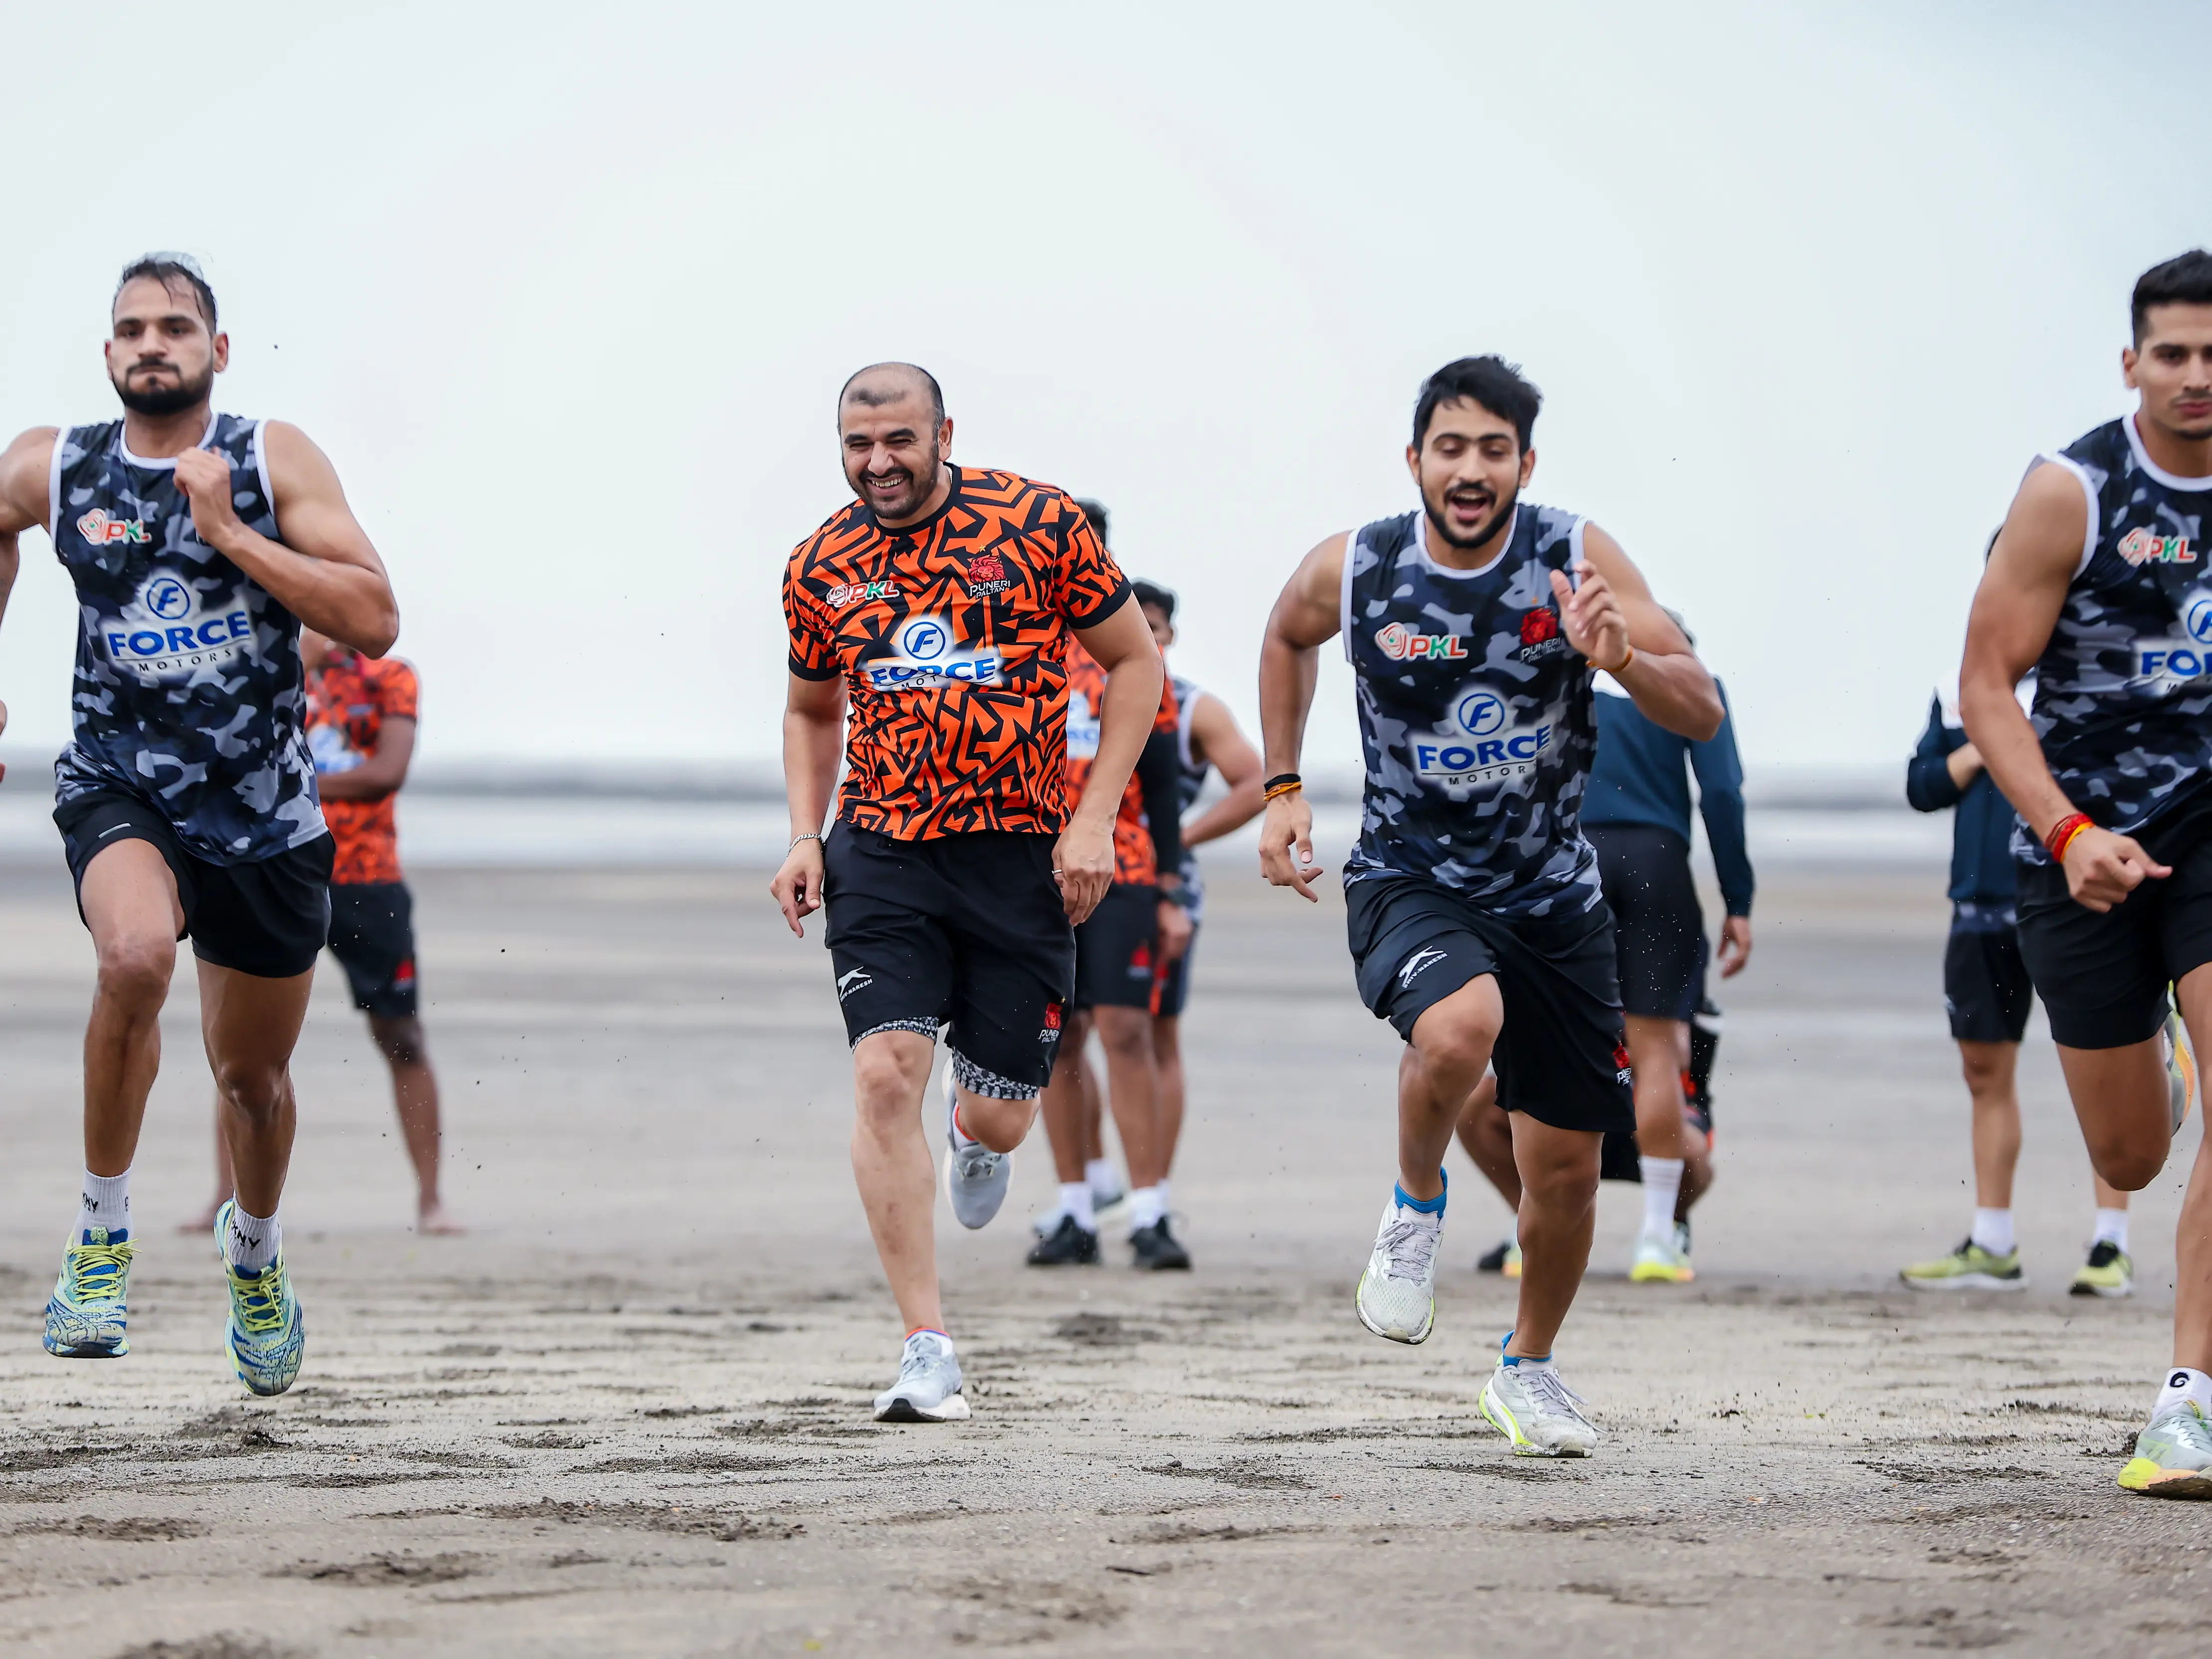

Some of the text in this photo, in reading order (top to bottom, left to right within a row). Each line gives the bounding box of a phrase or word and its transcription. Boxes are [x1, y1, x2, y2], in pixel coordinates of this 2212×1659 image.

[2150, 539, 2194, 559] PKL
[850, 581, 899, 601] PKL
[970, 580, 1011, 597] PUNERI
[976, 586, 1005, 599] PALTAN
[108, 611, 250, 657] FORCE
[1409, 636, 1466, 657] PKL
[1520, 637, 1561, 662] PUNERI
[1529, 647, 1556, 663] PALAN
[138, 648, 232, 672] MOTORS
[1417, 724, 1550, 770] FORCE
[1449, 762, 1536, 786] MOTOR
